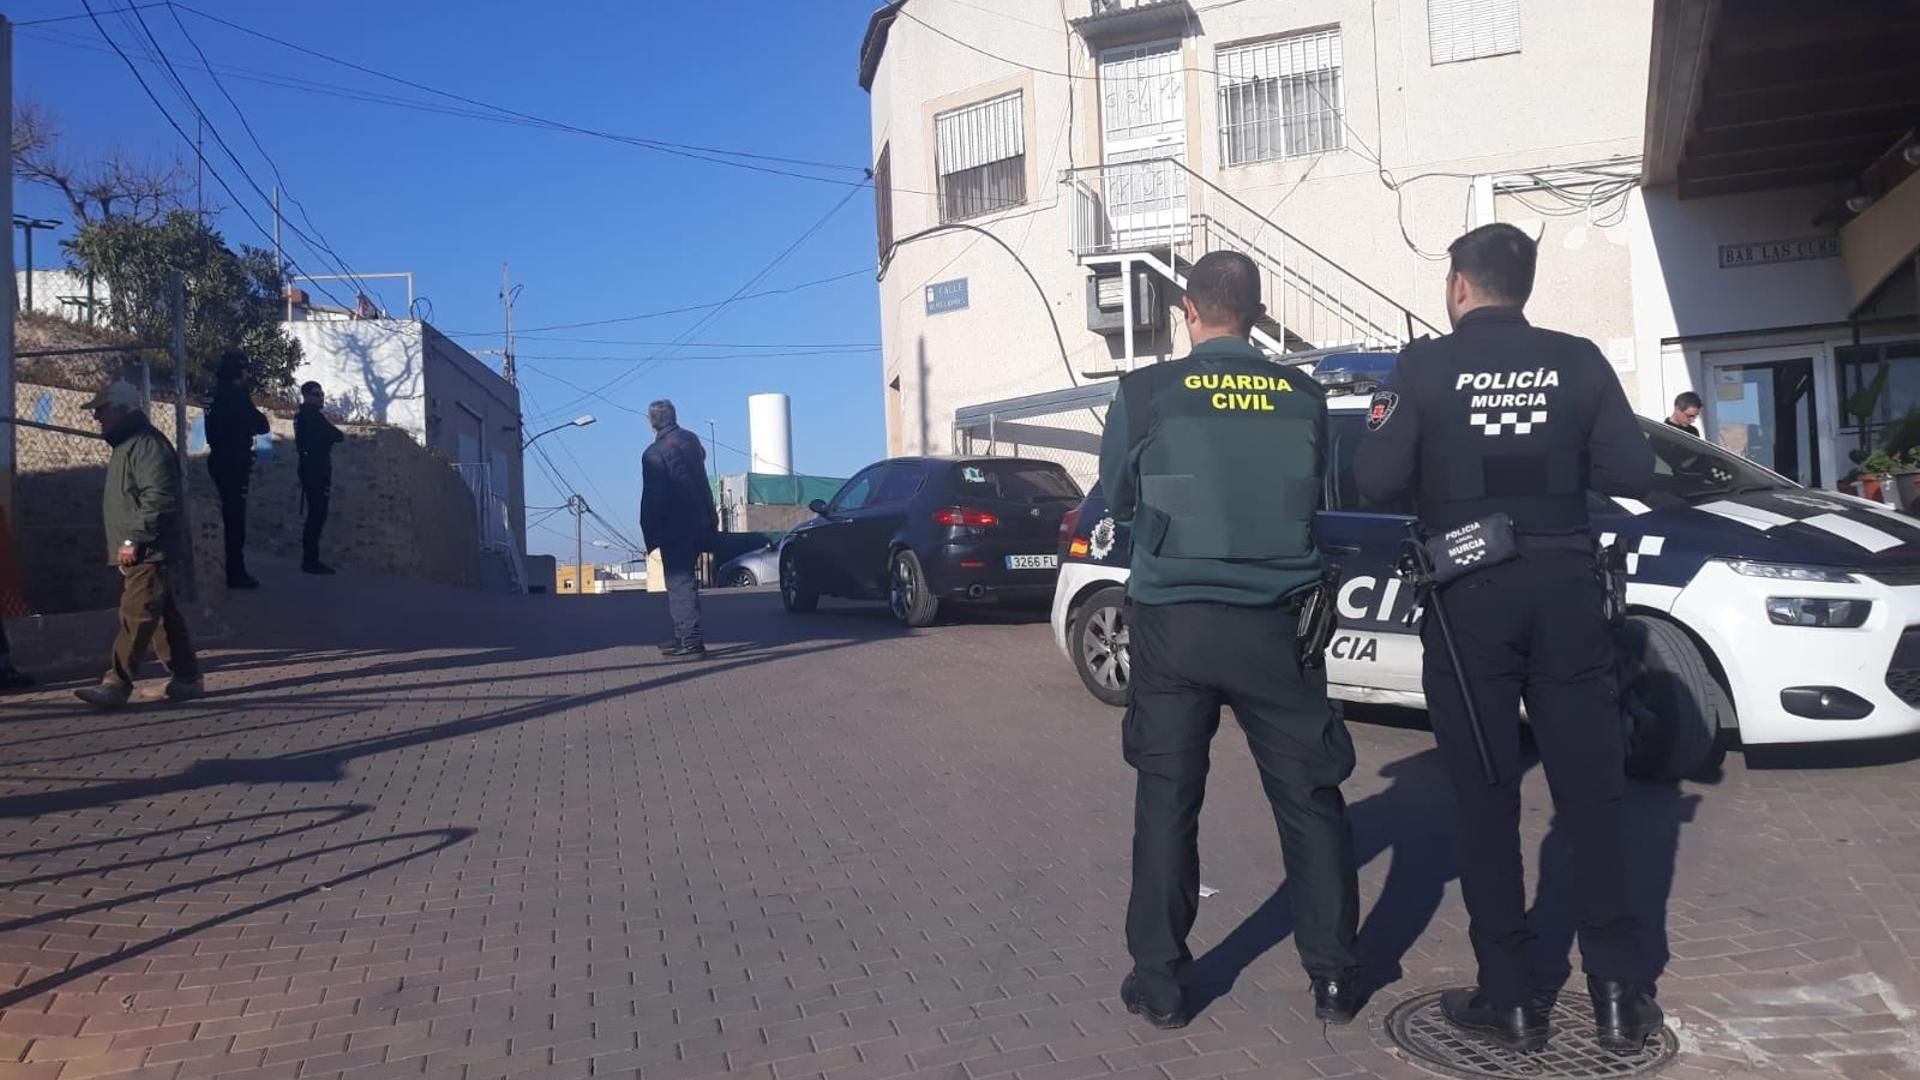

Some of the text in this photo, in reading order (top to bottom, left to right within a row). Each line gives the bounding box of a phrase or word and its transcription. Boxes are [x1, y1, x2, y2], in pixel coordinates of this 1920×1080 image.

[1726, 249, 1753, 264] BAR
[1762, 244, 1791, 260] LAS
[1184, 374, 1294, 392] GUARDIA
[1455, 367, 1560, 390] POLICÍA
[1211, 393, 1275, 411] CIVIL
[1471, 392, 1548, 408] MURCIA
[1445, 521, 1481, 541] POLICIA
[1448, 537, 1486, 557] MURCIA
[1013, 556, 1041, 568] 3266
